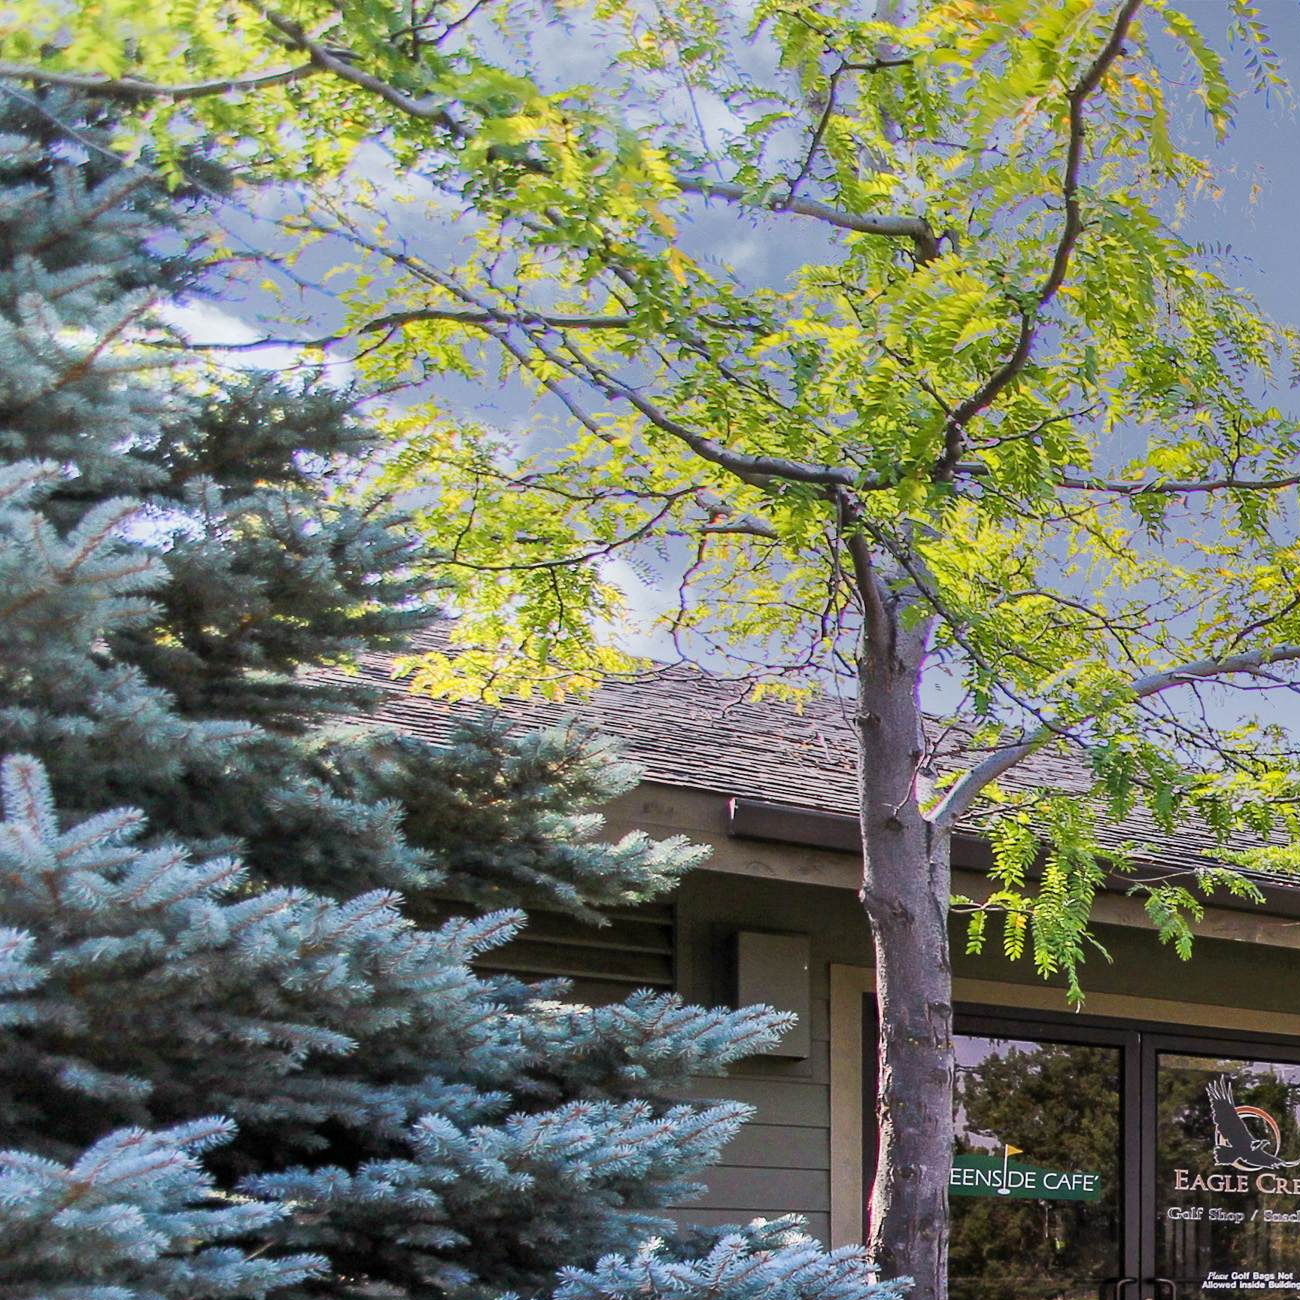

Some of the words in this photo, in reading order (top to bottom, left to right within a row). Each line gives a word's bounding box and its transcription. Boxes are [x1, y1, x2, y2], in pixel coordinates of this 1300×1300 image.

[1174, 1169, 1249, 1193] EAGLE
[1167, 1206, 1204, 1220] Golf
[1208, 1208, 1245, 1224] Shop
[1231, 1271, 1250, 1280] Golf
[1252, 1272, 1275, 1282] Bags
[1277, 1272, 1294, 1280] Not
[1202, 1281, 1237, 1289] Allowed
